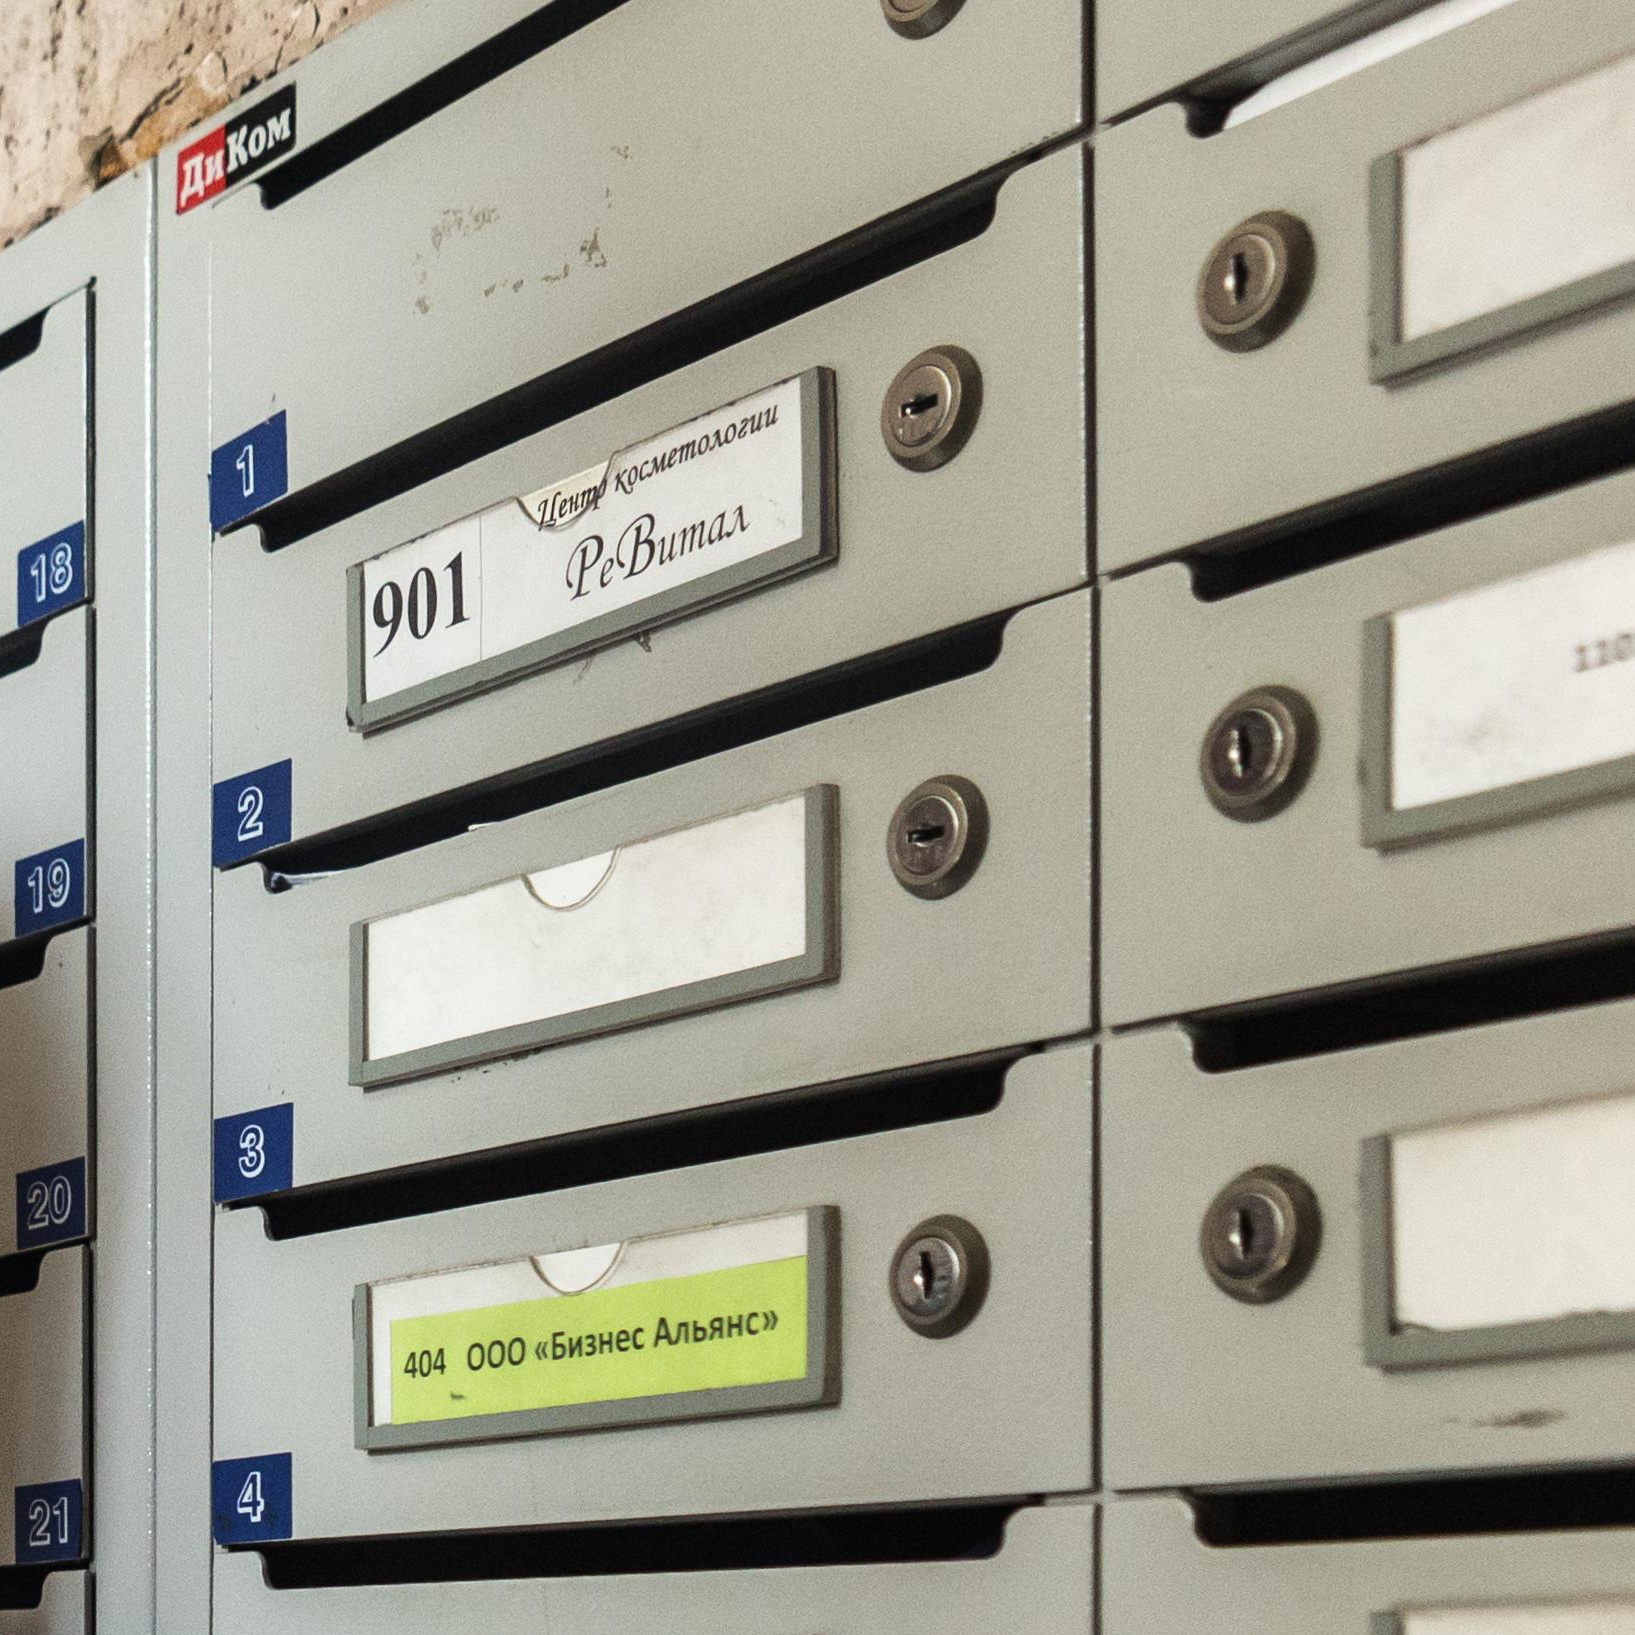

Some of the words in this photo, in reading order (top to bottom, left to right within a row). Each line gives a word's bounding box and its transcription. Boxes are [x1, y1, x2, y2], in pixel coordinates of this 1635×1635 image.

[180, 105, 292, 199] ДиКом
[235, 444, 256, 497] 1
[536, 476, 608, 530] Центр
[614, 403, 780, 494] косметологии
[30, 543, 74, 602] 18
[566, 503, 750, 600] РеВитал
[372, 551, 471, 658] 901
[238, 786, 264, 841] 2
[28, 858, 71, 913] 19
[239, 1123, 264, 1180] 3
[28, 1176, 71, 1230] 20
[403, 1347, 446, 1379] 404
[466, 1336, 526, 1372] ООО
[534, 1322, 645, 1361] «Бизнес
[652, 1305, 778, 1349] Альянс»
[30, 1497, 69, 1547] 21
[237, 1471, 264, 1523] 4
